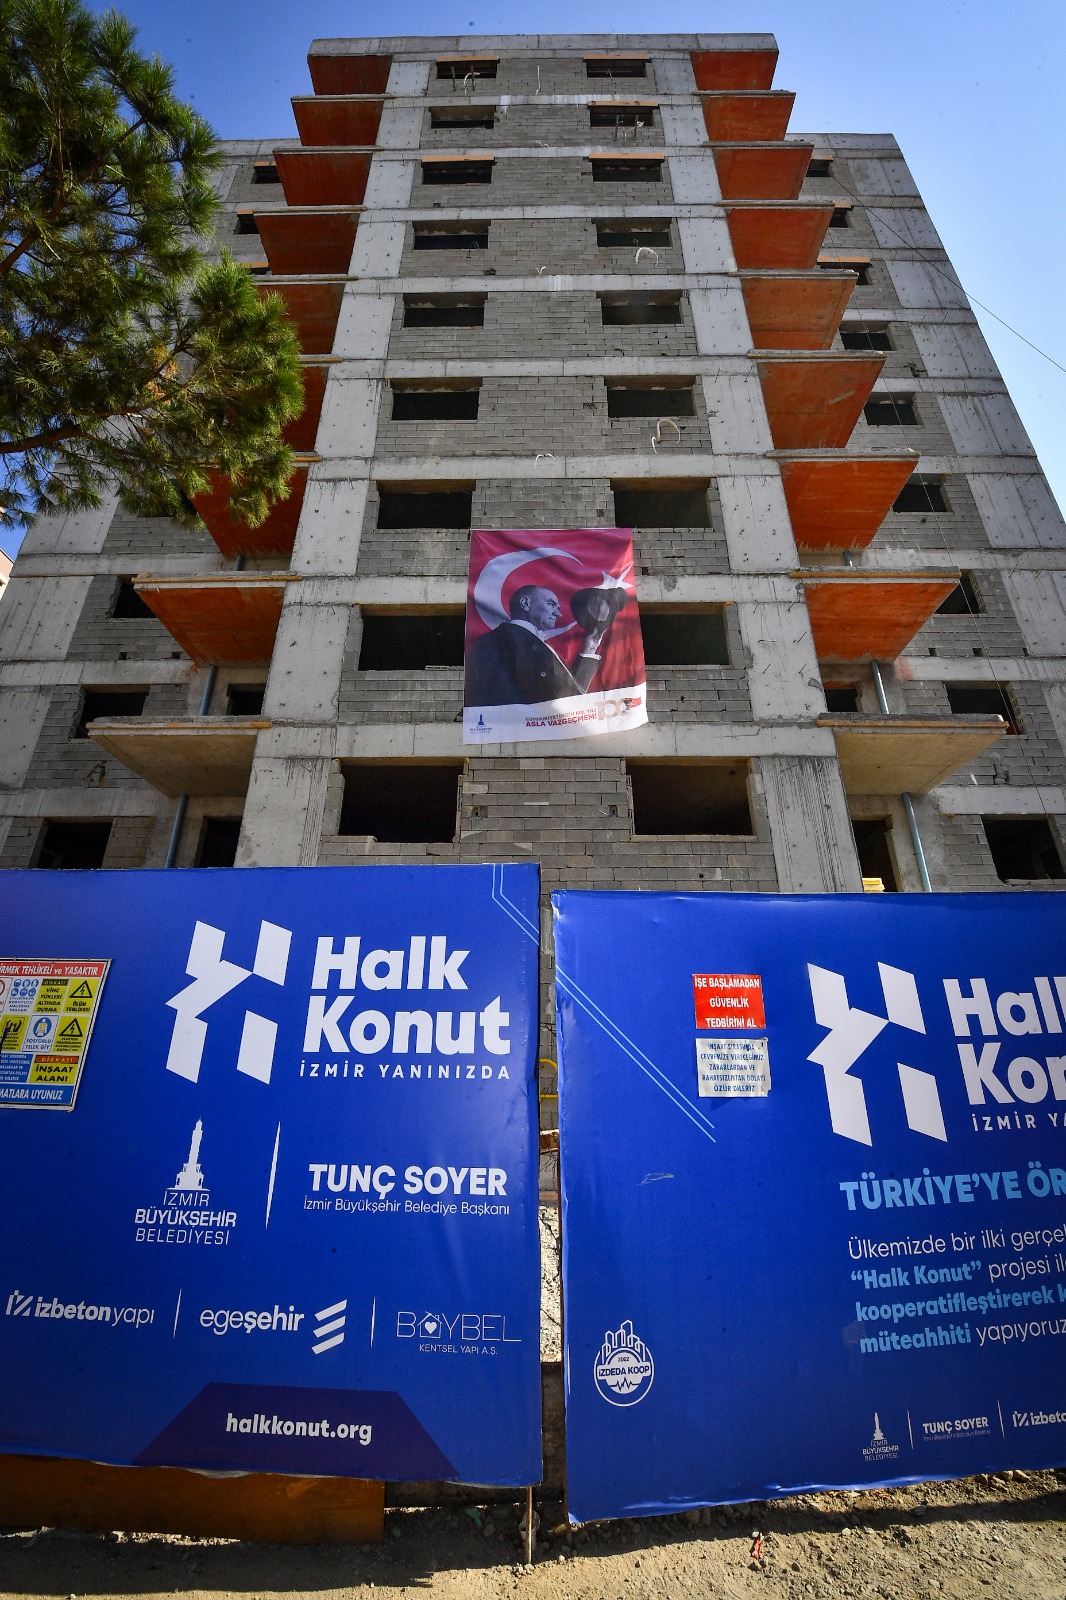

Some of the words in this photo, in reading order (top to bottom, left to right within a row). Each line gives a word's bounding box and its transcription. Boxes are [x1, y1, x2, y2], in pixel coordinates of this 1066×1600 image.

[526, 720, 546, 728] ASLA
[548, 713, 597, 726] VAZGEÇMEM!
[21, 963, 54, 975] TEHLİKELİ
[64, 966, 98, 976] YASAKTIR
[311, 935, 470, 991] Halk
[694, 976, 708, 990] İŞE
[709, 977, 760, 990] BAŞLAMADAN
[709, 995, 750, 1008] GÜVENLİK
[302, 995, 511, 1055] Konut
[705, 1016, 745, 1028] TEDBİRİNİ
[746, 1018, 757, 1028] AL
[35, 1064, 74, 1074] İNŞAAT
[299, 1060, 365, 1078] İZMİR
[379, 1064, 510, 1080] YANINIZDA
[30, 1089, 64, 1100] UYUNUZ
[713, 1083, 732, 1092] ÖZÜR
[971, 1110, 1037, 1132] İZMİR
[308, 1163, 396, 1200] TUNÇ
[403, 1165, 508, 1196] SOYER
[163, 1190, 210, 1207] İZMİR
[303, 1195, 332, 1211] İzmir
[334, 1198, 401, 1213] Büyükşehir
[404, 1199, 459, 1216] Belediye
[460, 1200, 510, 1216] Başkanı
[134, 1208, 237, 1228] BÜYÜKŞEHİR
[135, 1227, 230, 1245] BELEDİYESİ
[848, 1234, 947, 1260] Ülkemizde
[950, 1231, 976, 1251] bir
[981, 1228, 1006, 1249] ilki
[1010, 1223, 1066, 1252] gerçe
[988, 1254, 1051, 1283] projesi
[1054, 1253, 1066, 1273] il
[855, 1285, 1055, 1323] kooperatifleştirerek
[199, 1305, 305, 1336] egeşehir
[859, 1322, 973, 1354] müteahhiti
[419, 1343, 458, 1354] KENTSEL
[460, 1345, 480, 1356] YAPI
[481, 1346, 499, 1356] A.Ş.
[628, 1365, 649, 1376] KOOP
[225, 1412, 374, 1446] halkkonut.org
[922, 1420, 954, 1435] TUNÇ
[954, 1416, 990, 1431] SOYER
